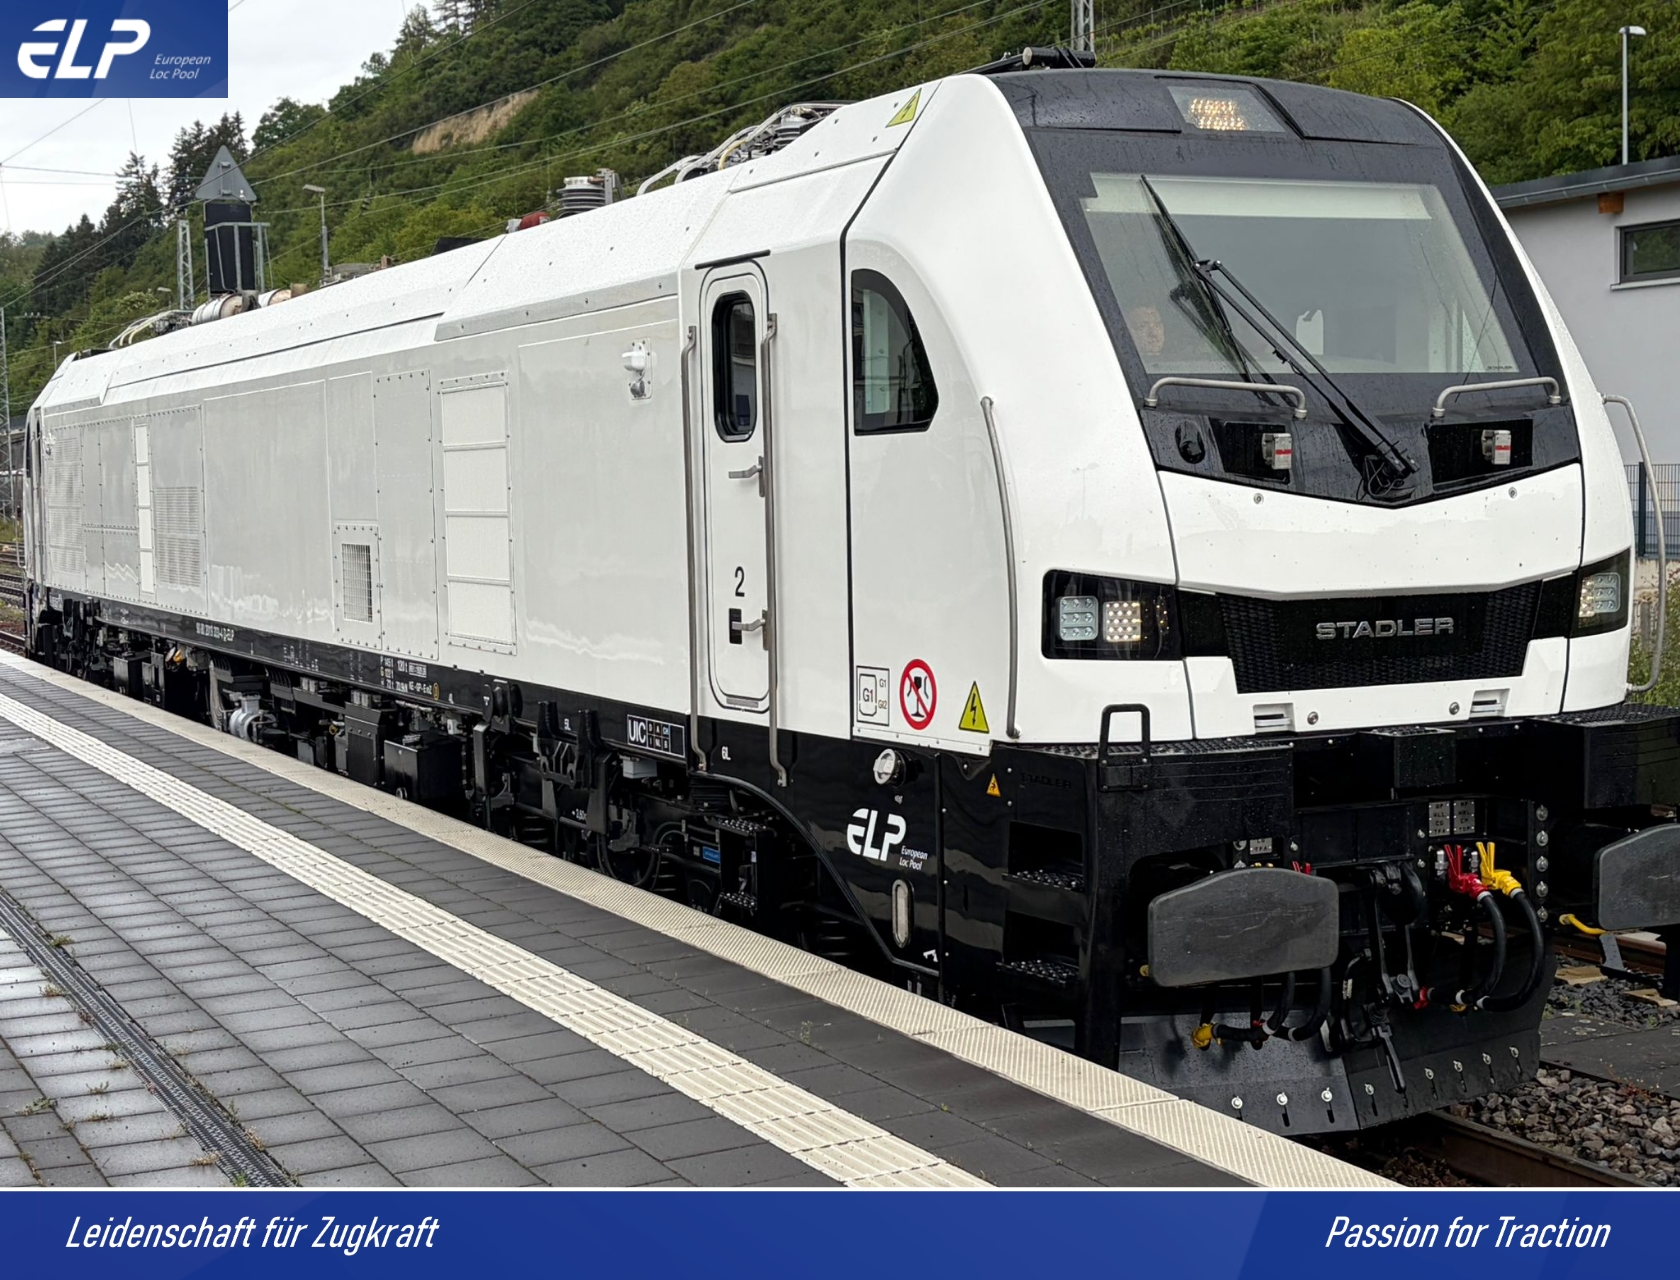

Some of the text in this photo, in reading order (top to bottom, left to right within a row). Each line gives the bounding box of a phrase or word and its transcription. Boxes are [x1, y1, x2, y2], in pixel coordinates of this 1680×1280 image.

[734, 566, 745, 597] 2
[1315, 617, 1455, 640] STADLER
[879, 678, 887, 688] G1
[862, 687, 874, 703] G1
[628, 720, 646, 743] UIC
[648, 723, 653, 732] D
[656, 725, 660, 733] A
[846, 808, 907, 861] ELP
[901, 845, 928, 860] European
[899, 856, 923, 870] Loc Pool
